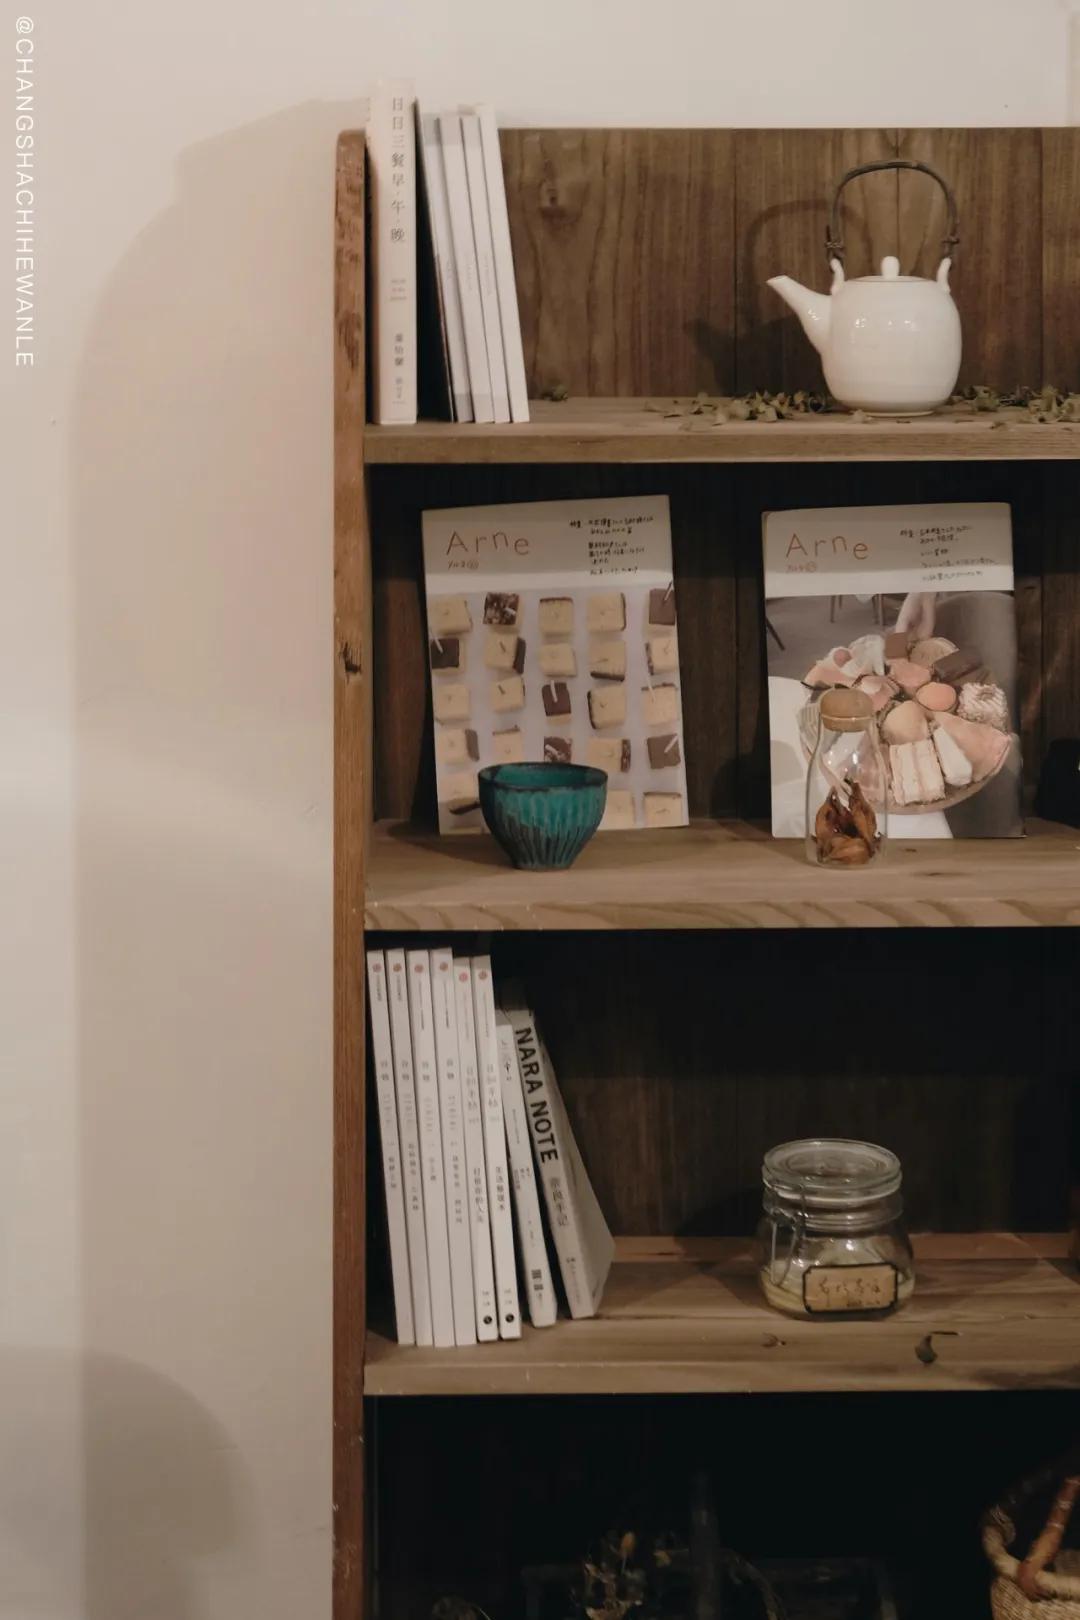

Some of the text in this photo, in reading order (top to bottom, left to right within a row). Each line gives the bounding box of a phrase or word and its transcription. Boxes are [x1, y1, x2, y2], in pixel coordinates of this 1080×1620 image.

[447, 531, 530, 557] Arne
[786, 533, 869, 560] Arne
[515, 1027, 558, 1163] NARA NOTE
